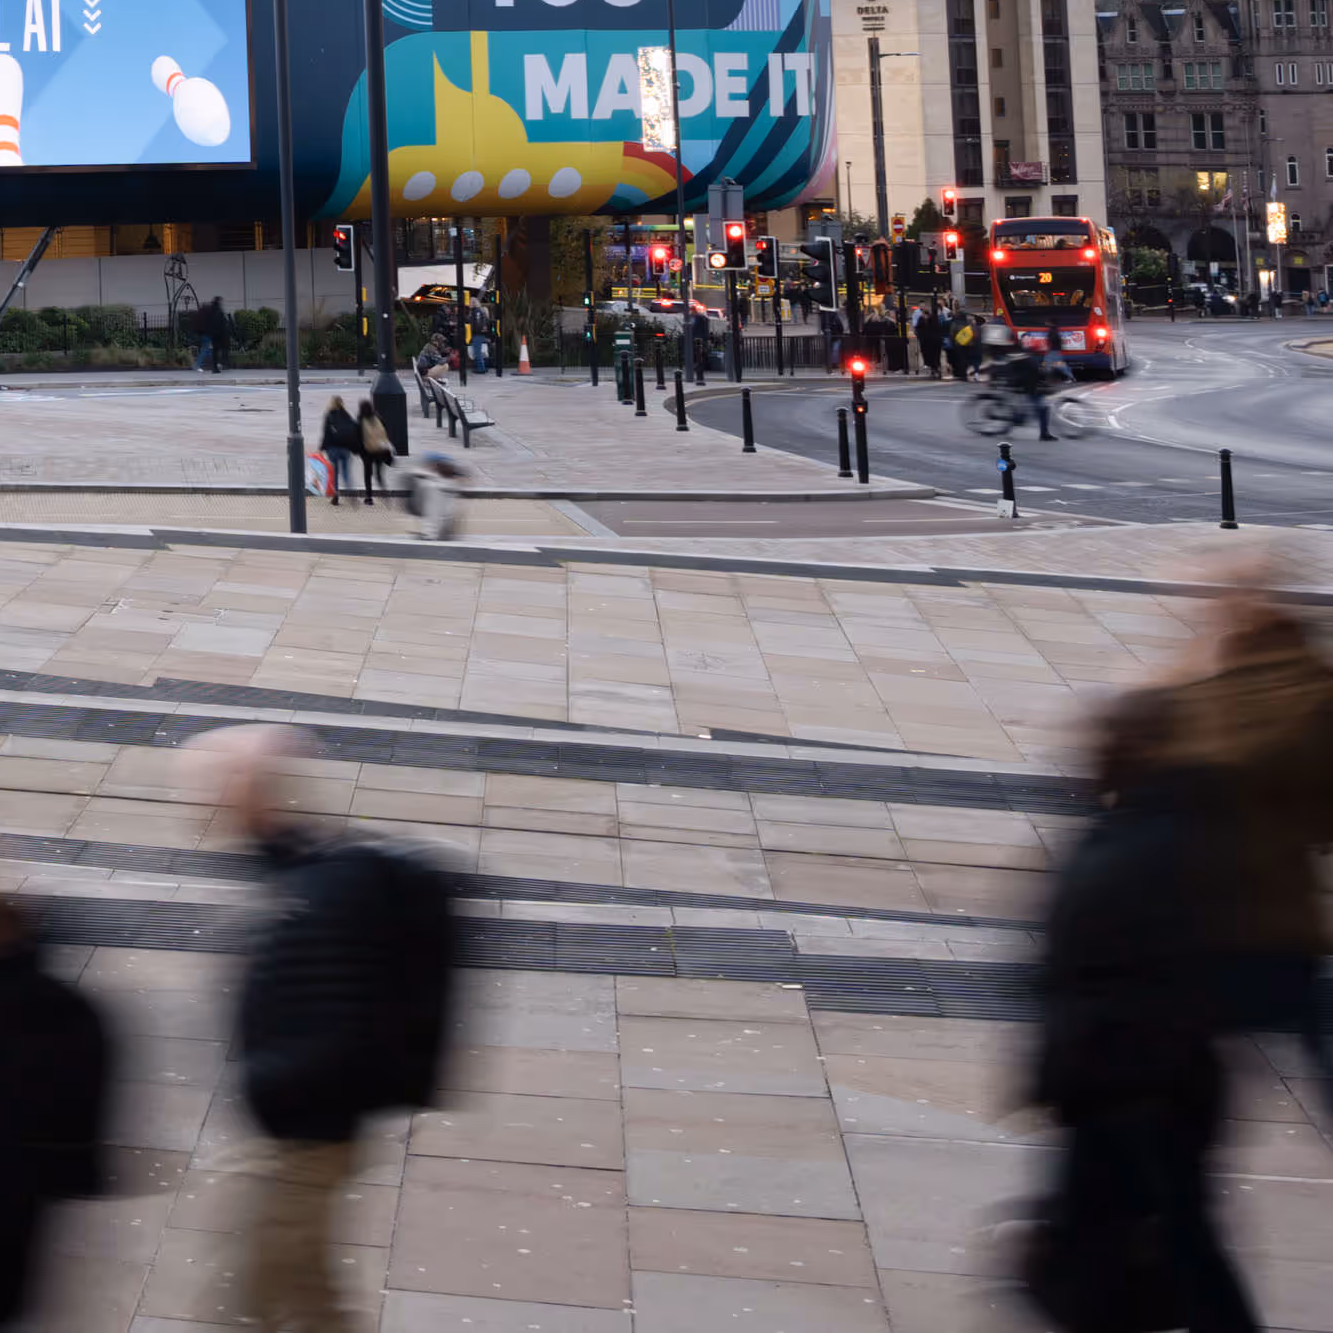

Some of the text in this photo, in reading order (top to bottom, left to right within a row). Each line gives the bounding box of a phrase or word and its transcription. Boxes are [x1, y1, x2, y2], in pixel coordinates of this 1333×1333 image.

[856, 5, 889, 15] DELTA
[524, 52, 750, 121] MADE
[1038, 272, 1053, 284] 20
